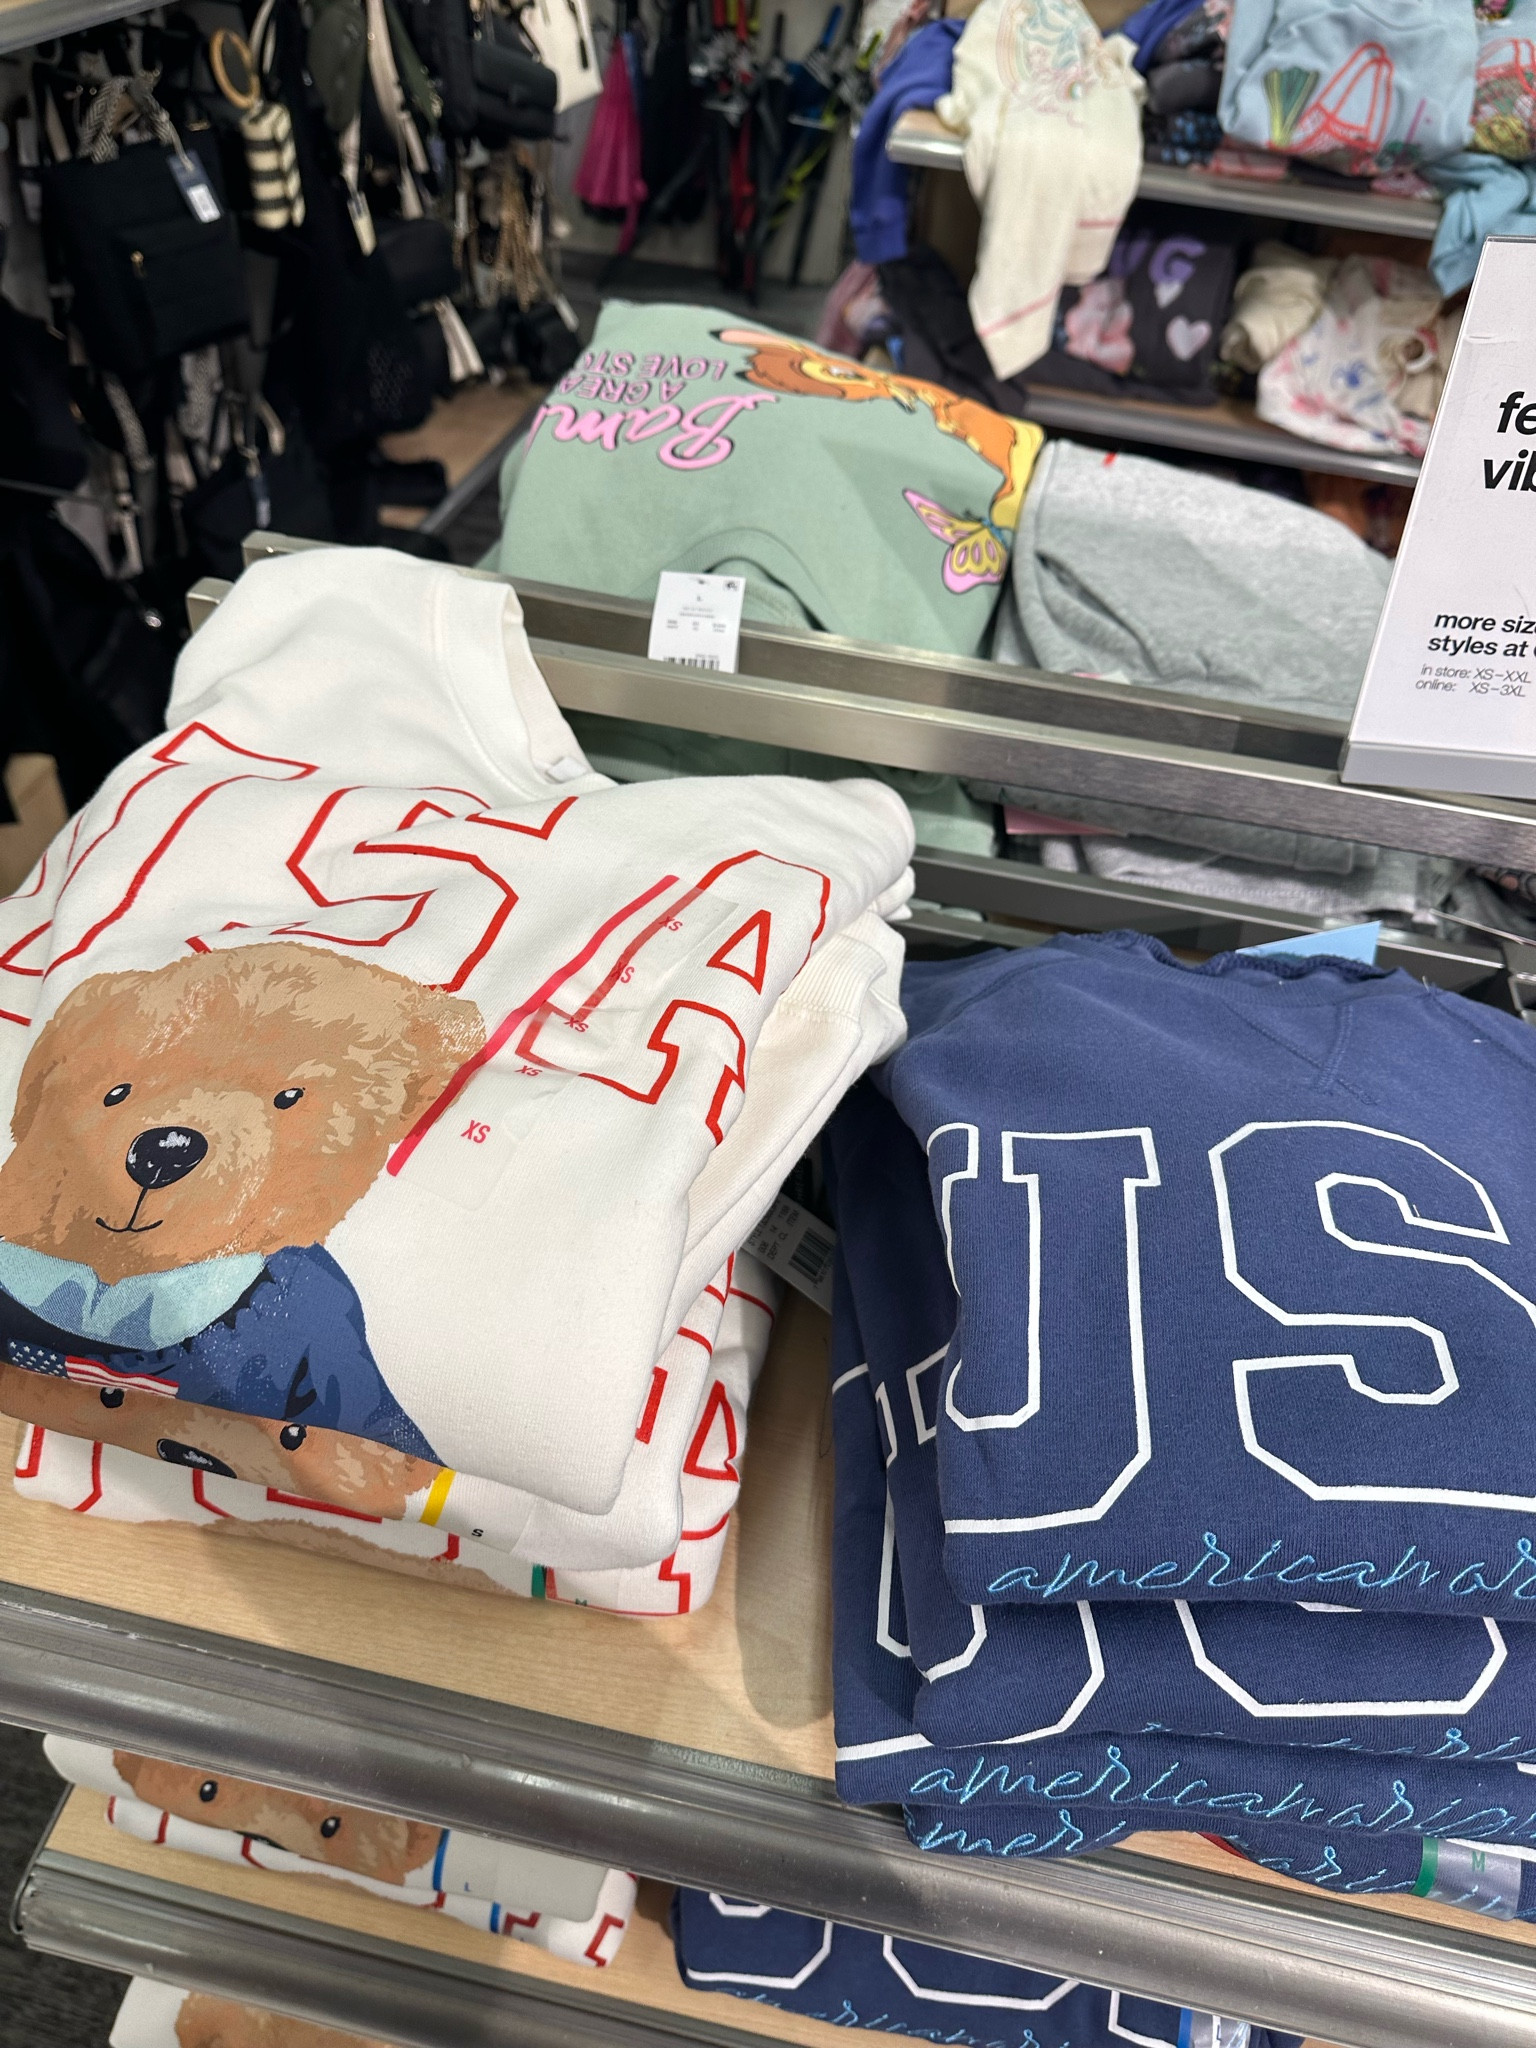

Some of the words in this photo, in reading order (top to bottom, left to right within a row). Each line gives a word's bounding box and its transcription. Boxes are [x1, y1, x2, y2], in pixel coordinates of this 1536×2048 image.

[638, 354, 728, 381] LOVE
[659, 380, 686, 401] A
[524, 393, 778, 470] Bam
[1434, 614, 1496, 631] more
[1501, 615, 1536, 634] siz
[1427, 635, 1498, 656] styles
[1503, 641, 1529, 657] at
[1420, 663, 1432, 676] in
[1435, 666, 1471, 679] store:
[1415, 680, 1456, 692] online:
[660, 916, 683, 931] XS
[611, 962, 635, 983] XS
[564, 1017, 589, 1033] XS
[515, 1065, 543, 1077] XS
[460, 1119, 491, 1144] XS
[471, 1528, 484, 1537] S
[1471, 1851, 1486, 1872] M
